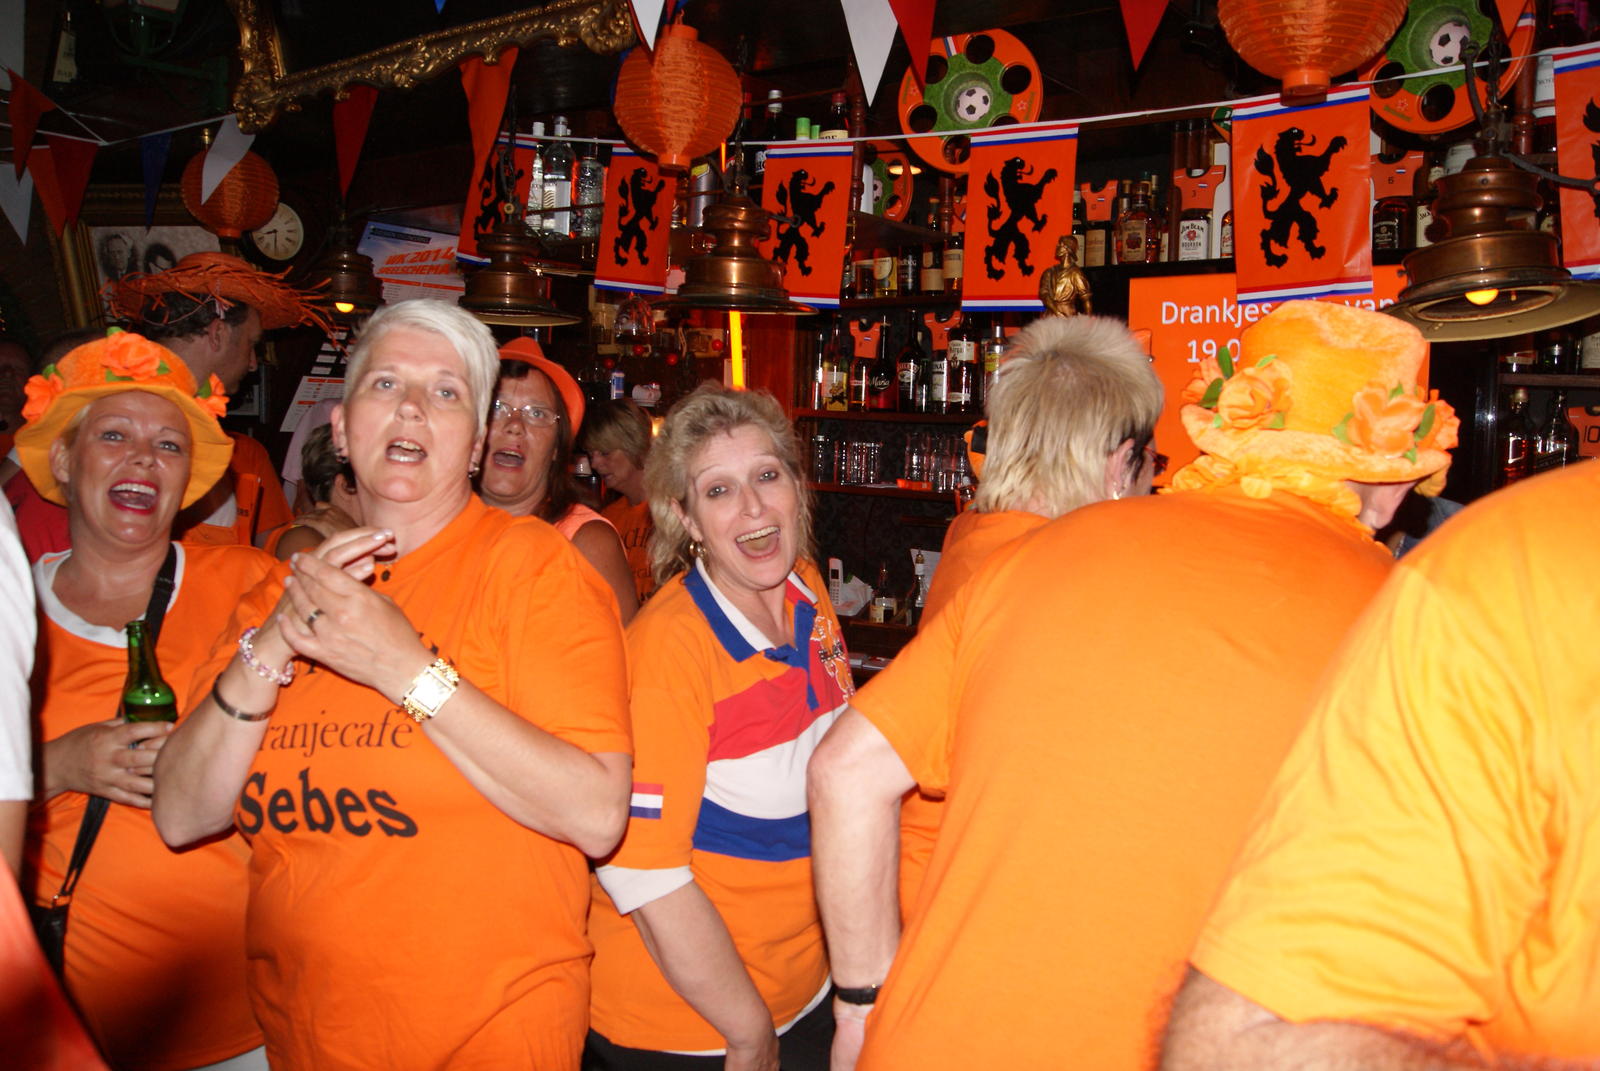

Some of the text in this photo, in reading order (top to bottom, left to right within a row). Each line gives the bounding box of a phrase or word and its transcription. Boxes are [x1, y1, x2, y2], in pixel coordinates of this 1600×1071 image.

[1388, 176, 1394, 184] 6
[1191, 189, 1197, 198] 3
[1190, 222, 1204, 233] BEAM
[385, 246, 455, 265] WK 2014
[376, 263, 450, 275] SPEELSCHEMA
[1161, 297, 1273, 329] Drankjes
[870, 375, 890, 388] Maria
[1583, 425, 1600, 443] 10
[257, 709, 413, 758] ranjecafé
[237, 766, 419, 838] Sebes
